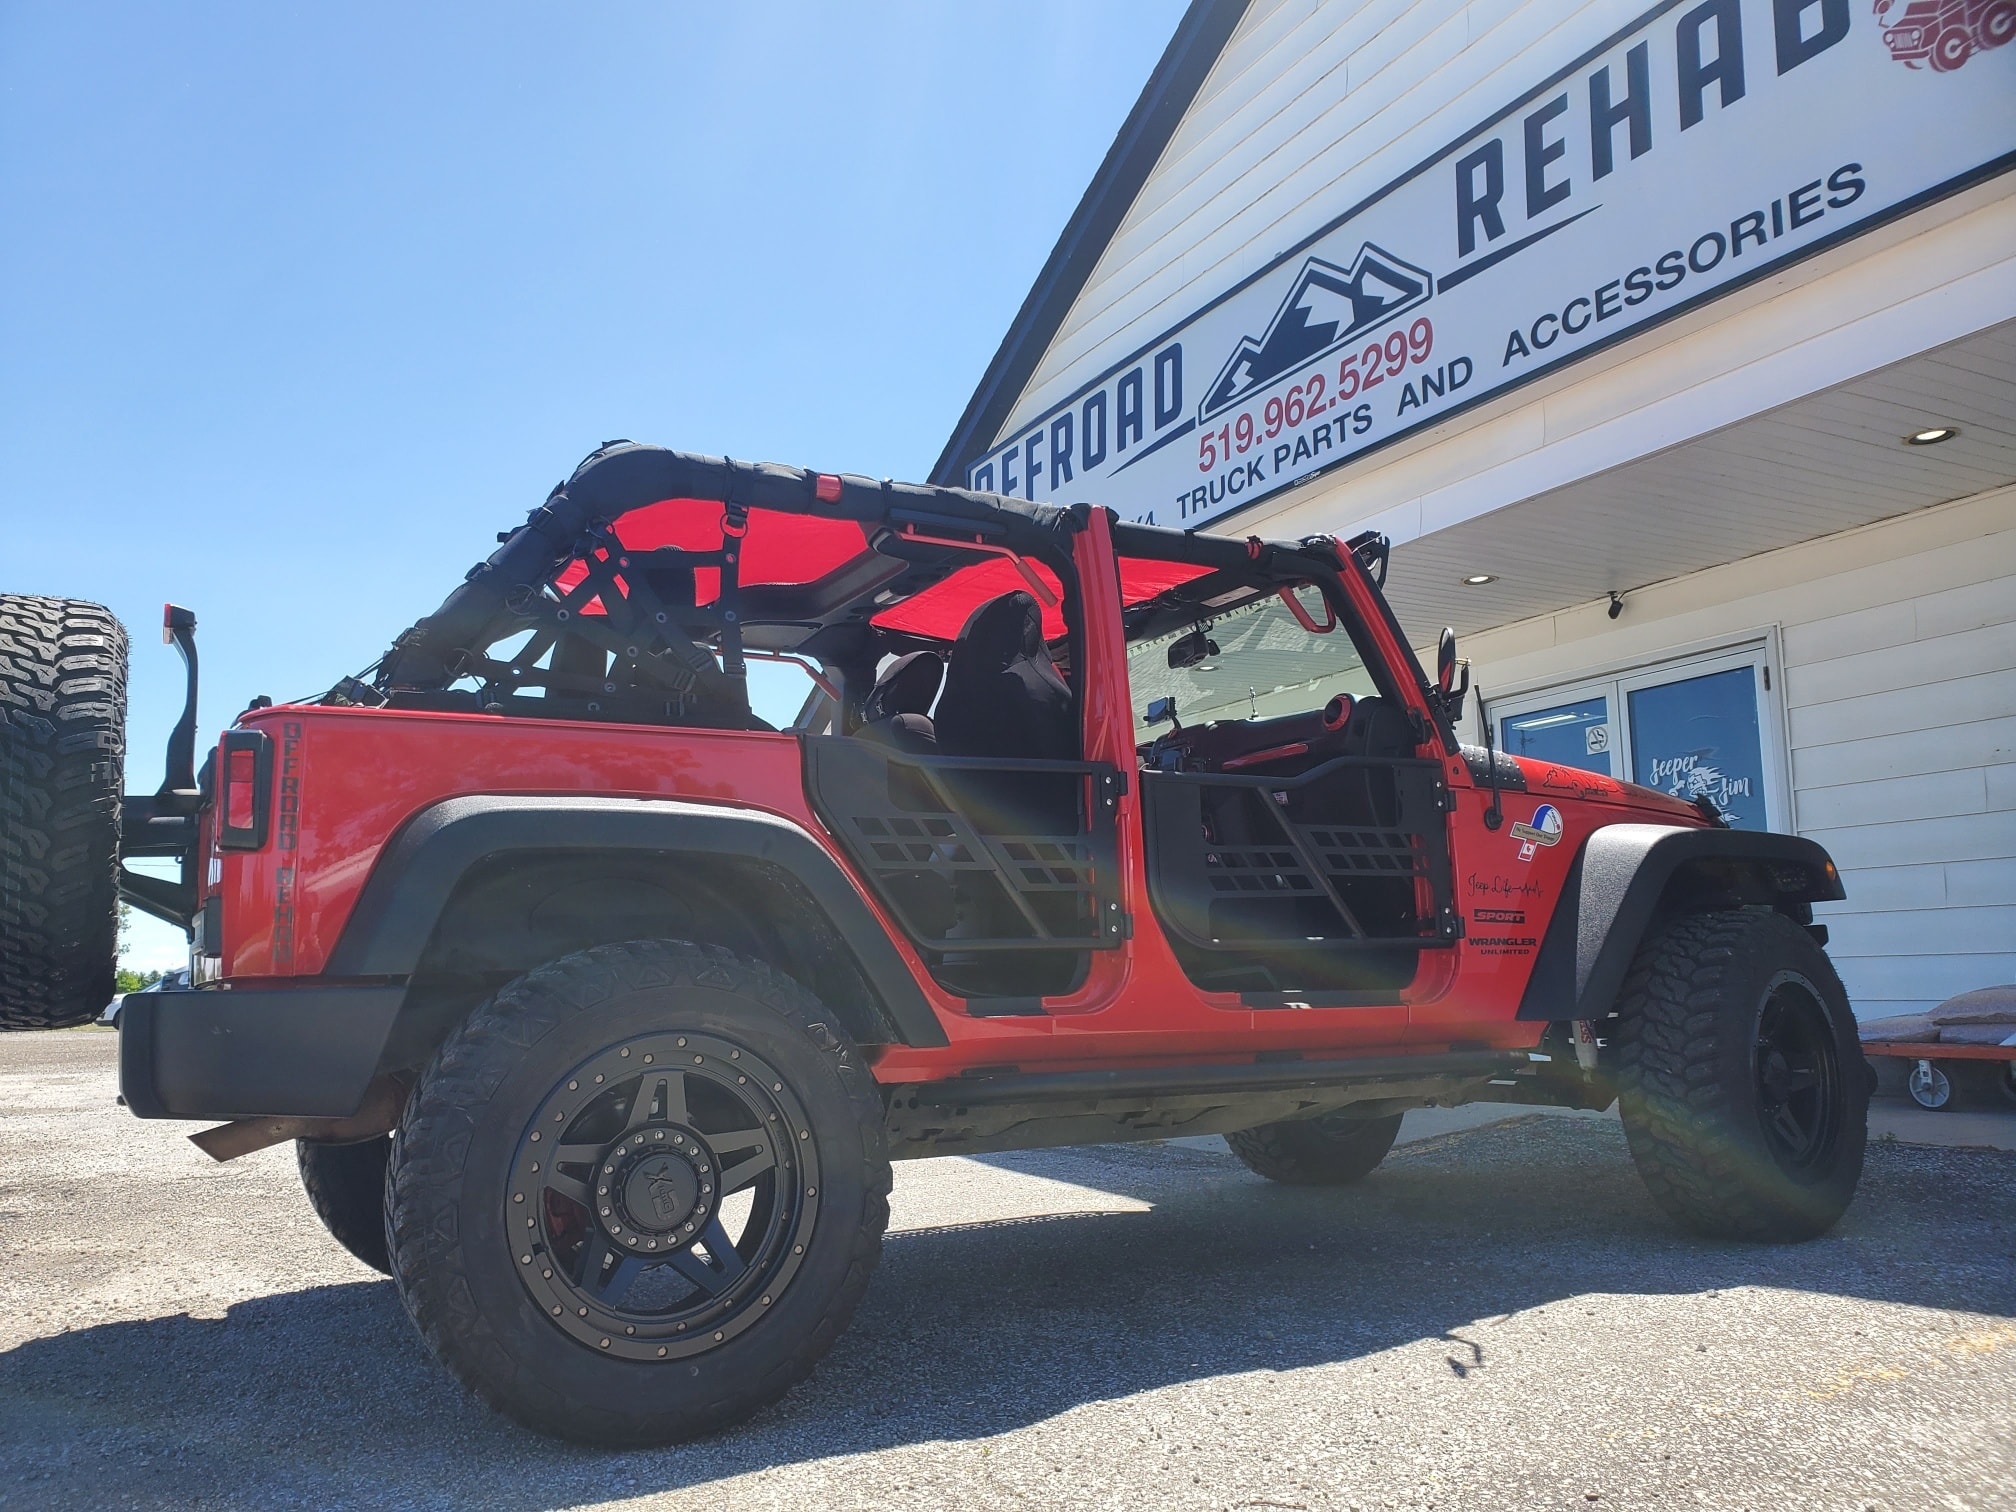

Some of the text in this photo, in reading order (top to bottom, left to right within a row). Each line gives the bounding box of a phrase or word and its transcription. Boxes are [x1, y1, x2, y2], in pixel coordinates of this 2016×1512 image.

[1455, 0, 1851, 260] REHAB
[1176, 162, 1867, 519] TRUCK PARTS AND ACCESSORIES
[1198, 317, 1434, 473] 519.962.5299
[1468, 872, 1512, 898] Jeep Life
[1475, 911, 1524, 922] SPORT
[1469, 937, 1537, 947] WRANGLER
[1480, 948, 1530, 956] UNLIMITED
